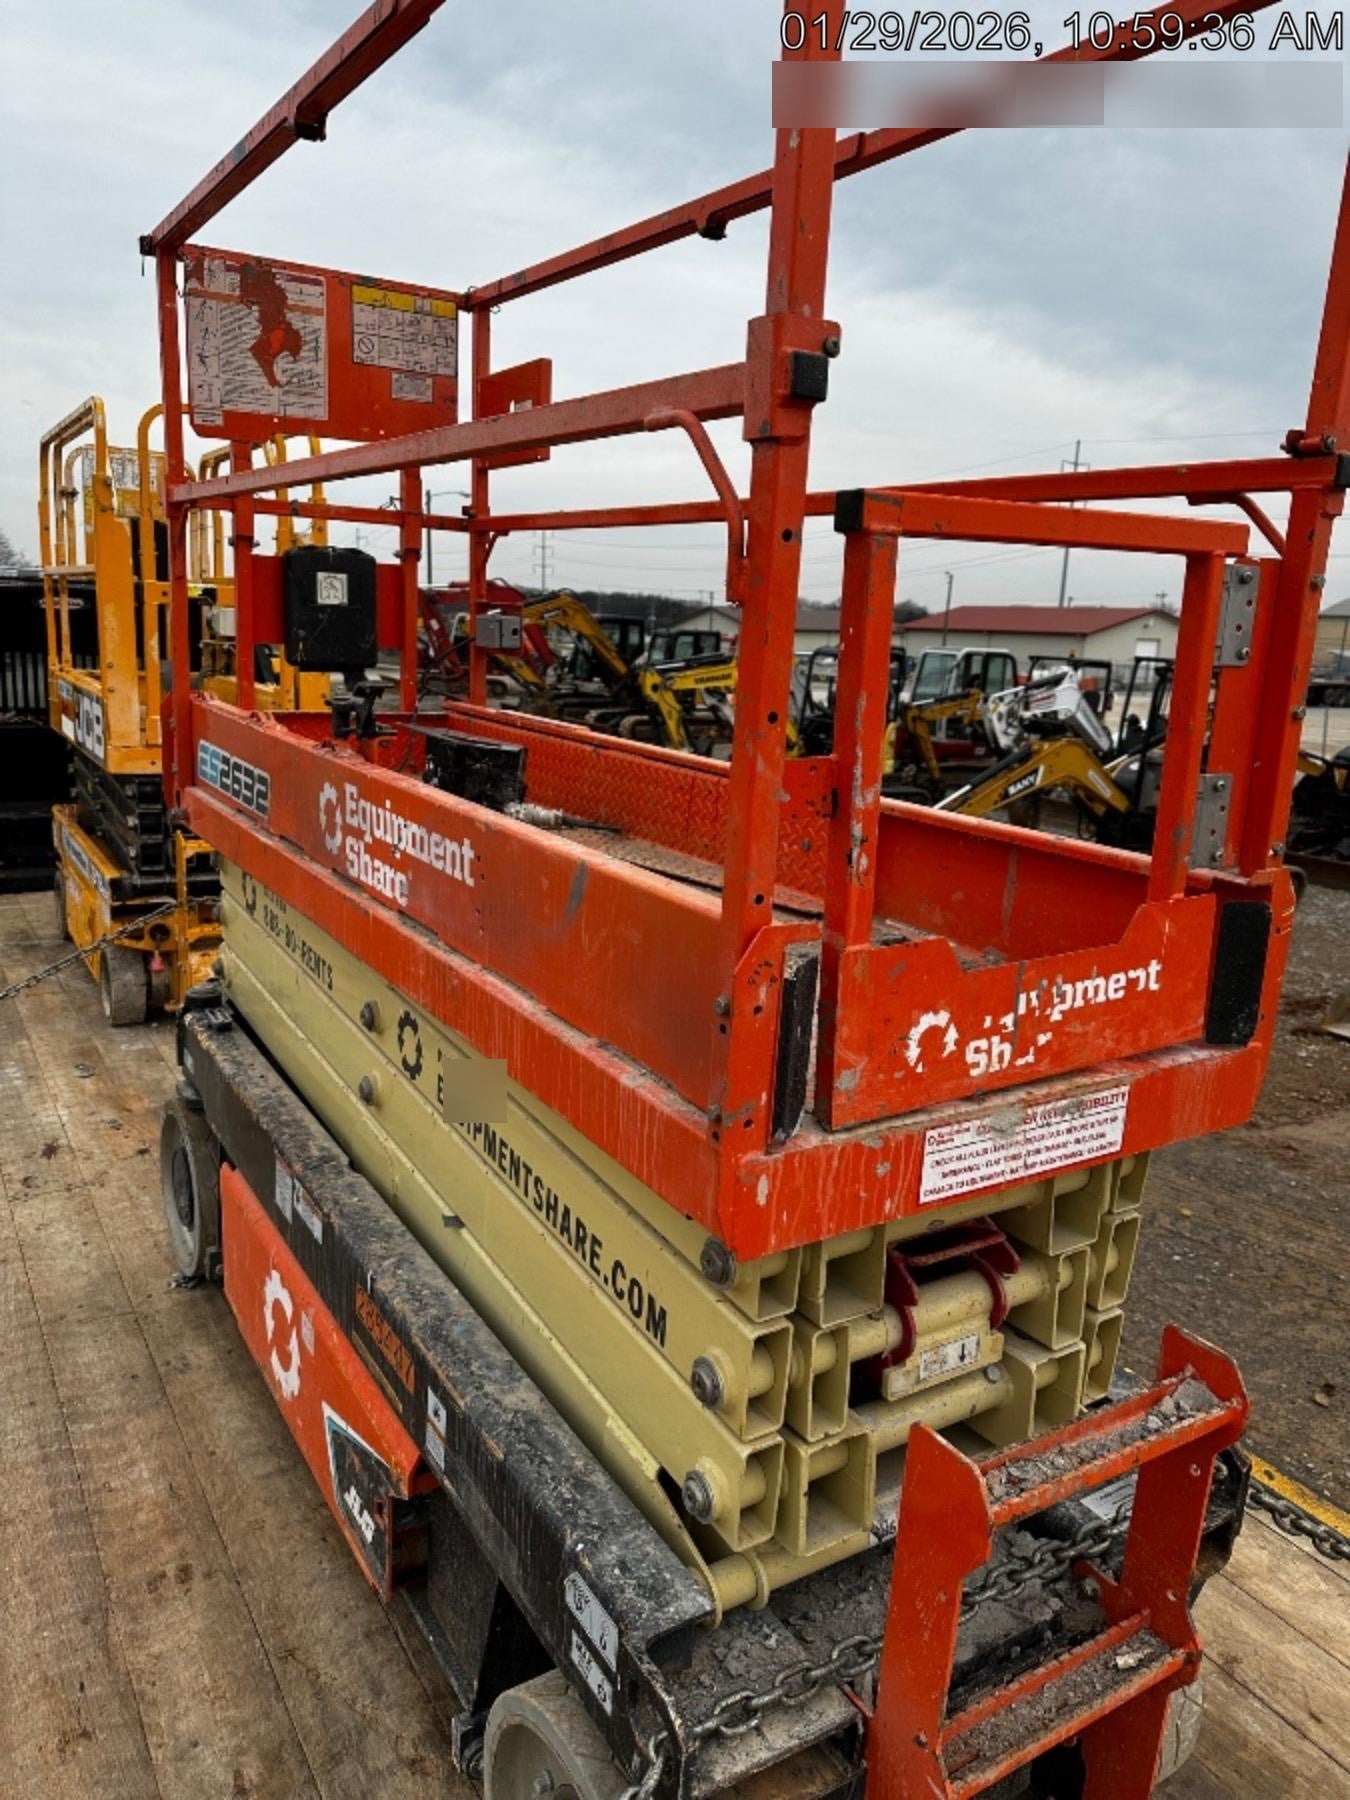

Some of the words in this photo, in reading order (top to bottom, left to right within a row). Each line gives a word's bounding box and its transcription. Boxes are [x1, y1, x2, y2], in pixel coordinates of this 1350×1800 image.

[199, 743, 269, 816] ES2632
[344, 782, 475, 888] Equipment
[345, 836, 409, 907] Share
[983, 959, 1163, 1034] upment
[437, 1073, 668, 1349] EPMENTSHARE.COM
